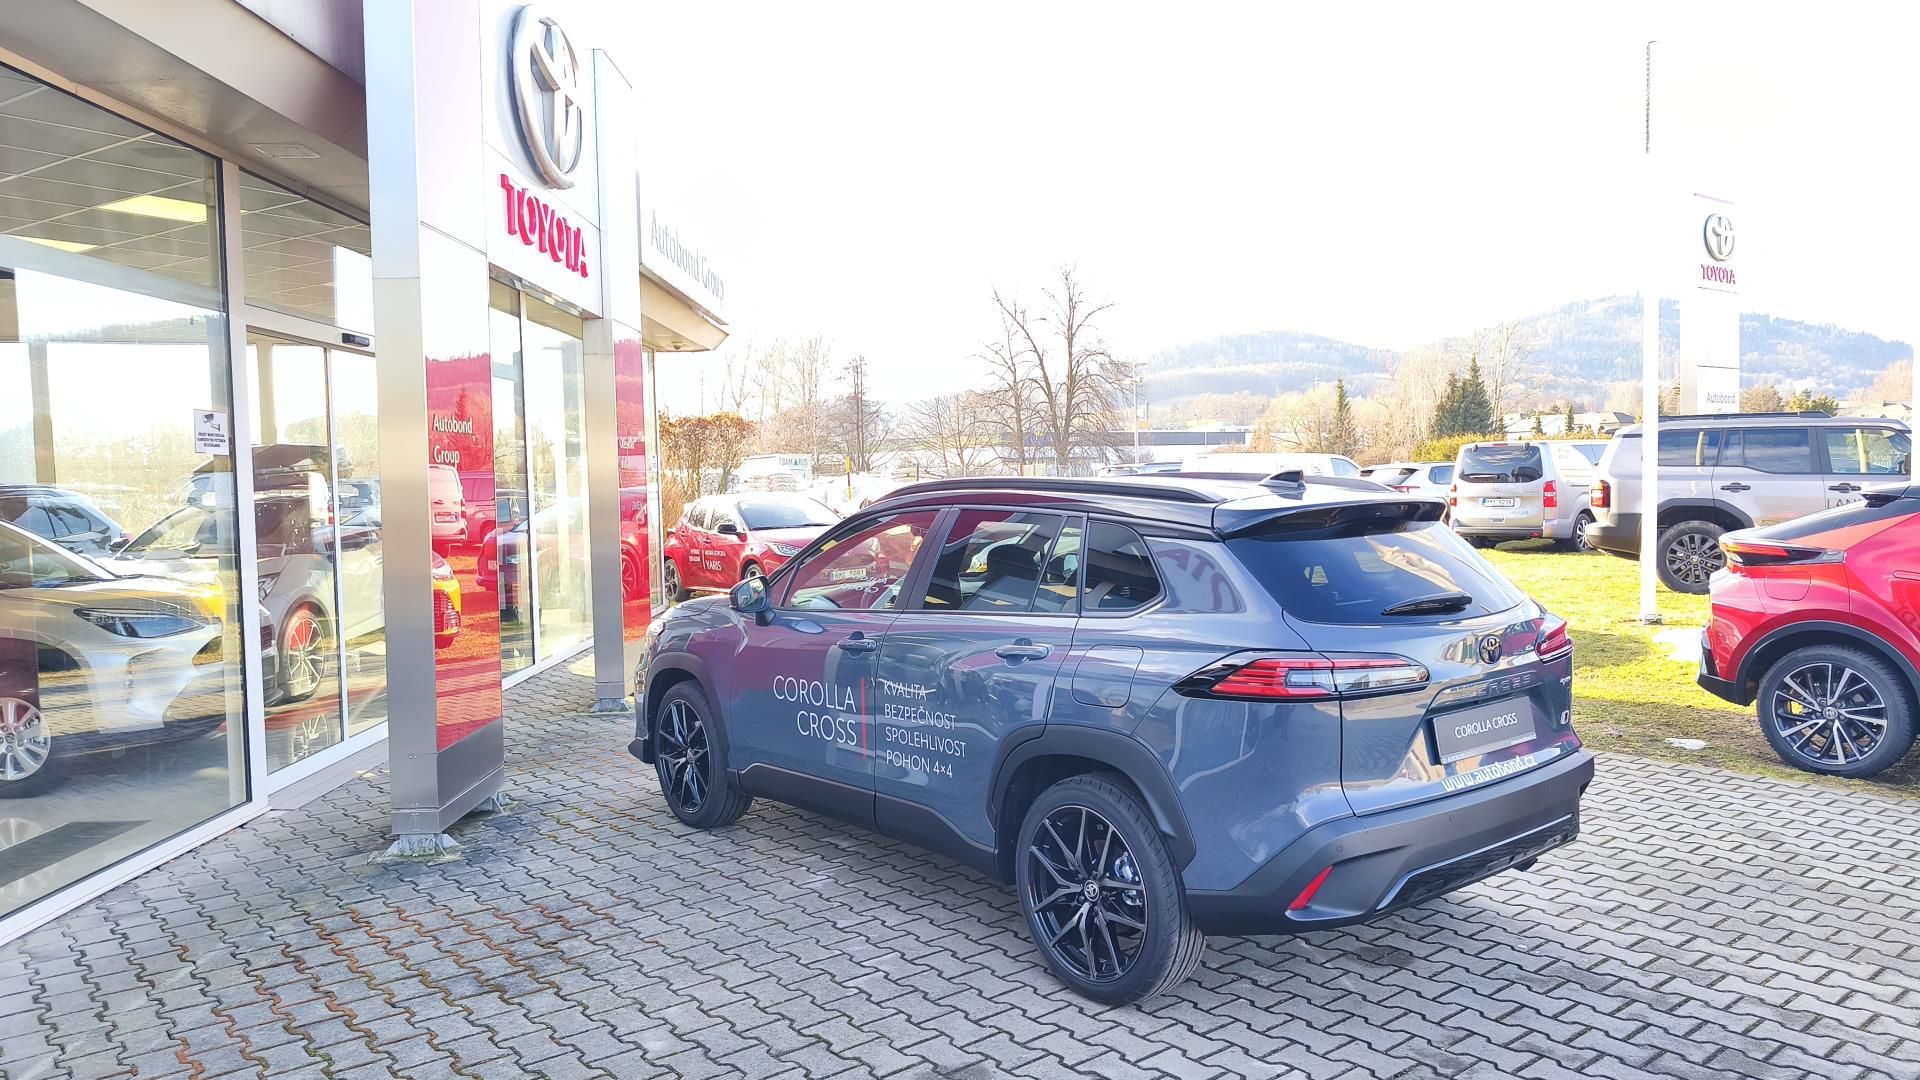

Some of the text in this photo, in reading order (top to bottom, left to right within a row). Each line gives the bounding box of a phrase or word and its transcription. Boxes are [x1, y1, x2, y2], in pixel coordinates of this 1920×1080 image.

[501, 173, 589, 278] TOYOTA
[651, 208, 724, 311] Autobond Group
[1700, 263, 1736, 285] TOYOTA
[1706, 391, 1736, 404] Autobond
[432, 414, 473, 434] Autobond
[433, 445, 460, 469] Group
[705, 559, 721, 571] YARIS
[773, 675, 857, 713] COROLLA
[884, 680, 927, 701] KVALITA
[797, 710, 857, 746] CROSS
[884, 703, 957, 731] BEZPEČNOST
[1455, 718, 1493, 739] COROLLA
[1492, 712, 1518, 730] CROSS
[885, 726, 967, 758] SPOLEHLIVOST
[886, 750, 930, 774] POHON
[1441, 755, 1538, 792] www.autobond.cz
